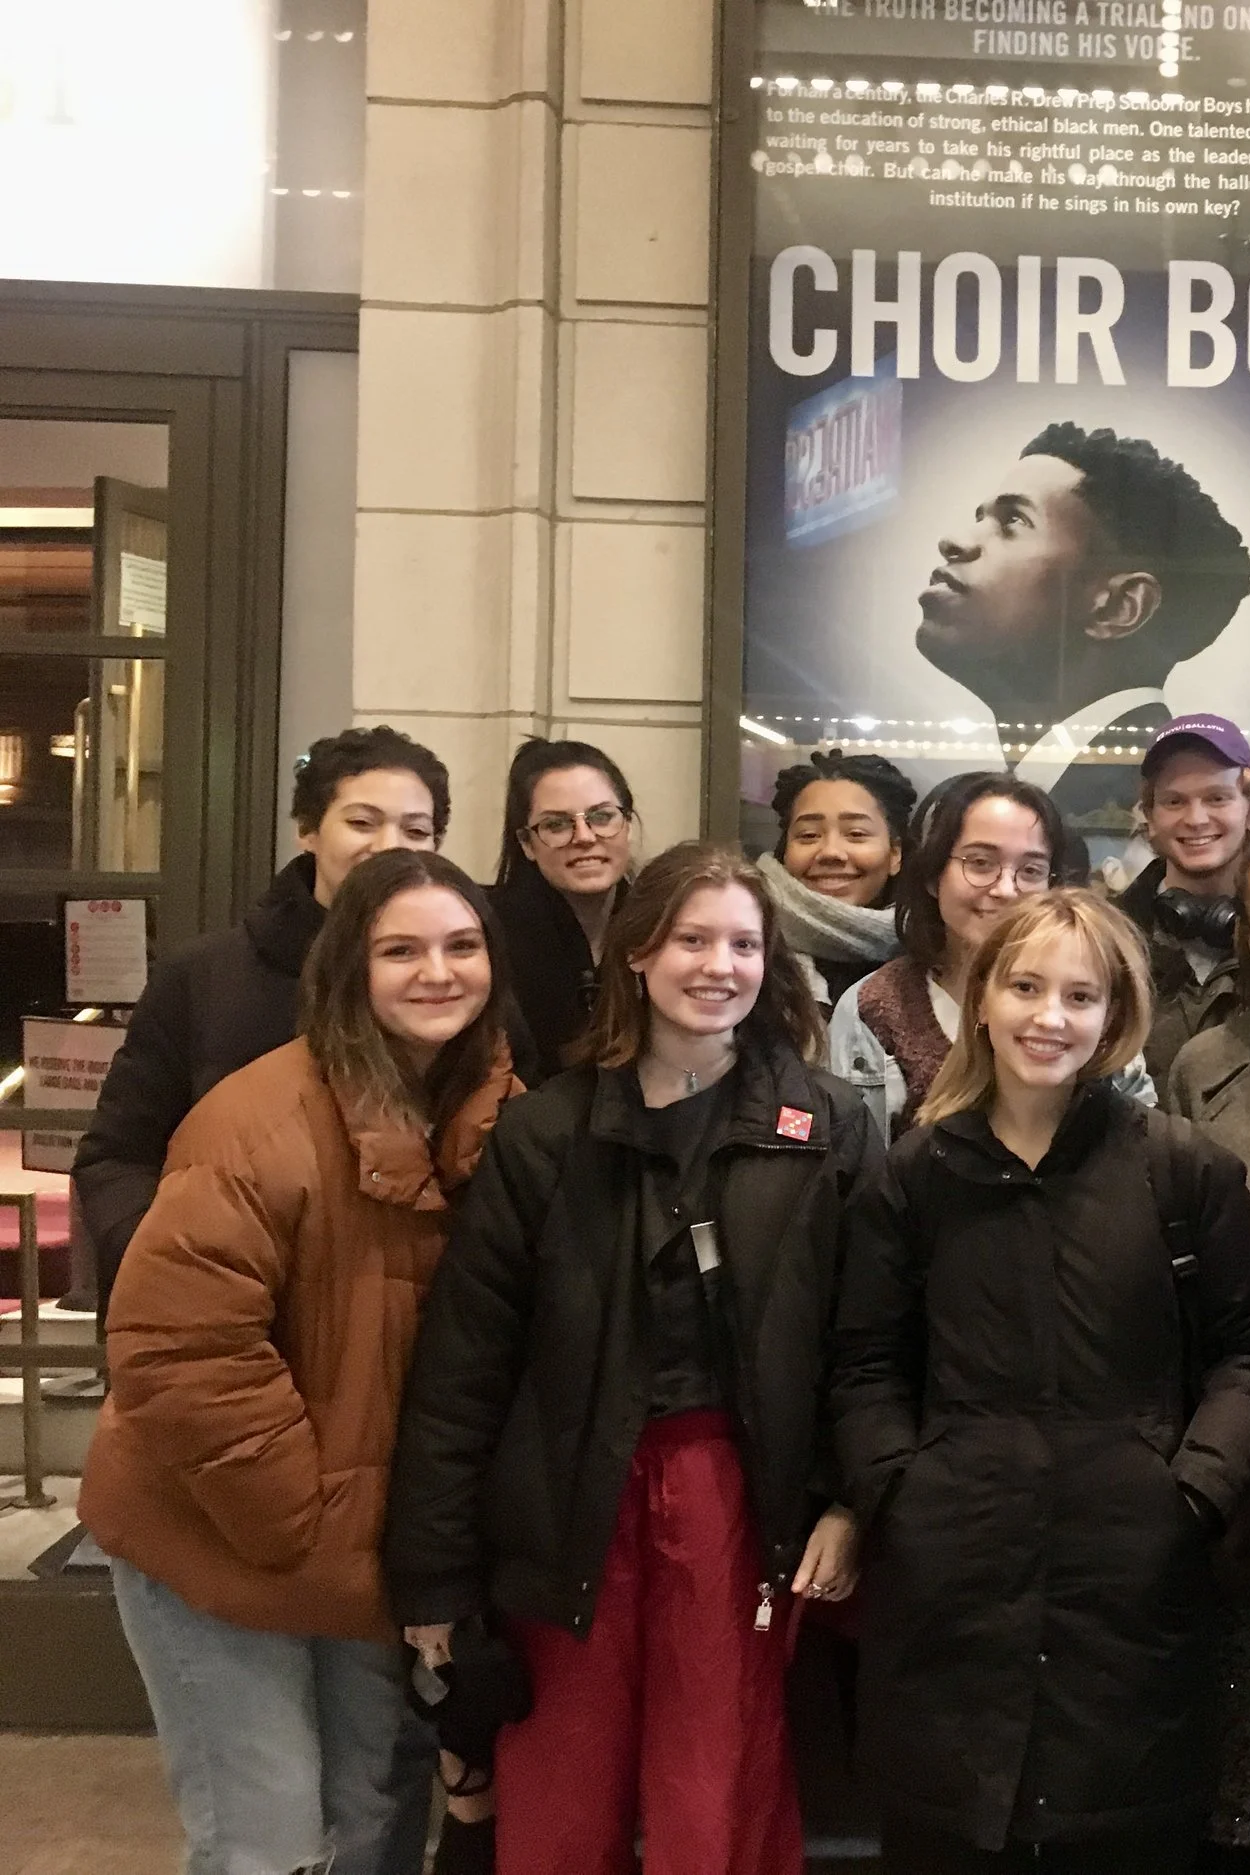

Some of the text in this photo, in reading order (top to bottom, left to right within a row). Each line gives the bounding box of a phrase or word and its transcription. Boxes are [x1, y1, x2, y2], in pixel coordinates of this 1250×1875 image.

[944, 0, 1067, 25] BECOMING
[1075, 1, 1089, 26] A
[1100, 2, 1161, 29] TRIAL
[1171, 3, 1215, 31] ND
[973, 29, 1201, 61] FINDING HIS VOIE.
[833, 88, 842, 99] a
[845, 86, 911, 105] century,
[946, 87, 1007, 105] Charles
[1012, 91, 1029, 107] R.
[1078, 93, 1116, 112] Prep
[1204, 97, 1242, 116] Boys
[766, 107, 783, 122] to
[788, 108, 815, 124] the
[820, 110, 903, 128] education
[908, 113, 925, 128] of
[929, 115, 986, 134] strong,
[991, 117, 1048, 133] ethical
[1053, 118, 1099, 135] black
[1103, 123, 1144, 137] men.
[1150, 121, 1182, 138] One
[766, 134, 827, 152] waiting
[836, 135, 859, 150] for
[865, 140, 910, 155] years
[918, 139, 935, 154] to
[943, 140, 978, 155] take
[987, 141, 1011, 157] his
[1020, 143, 1080, 161] rightful
[1089, 145, 1134, 163] place
[1142, 150, 1160, 162] as
[1169, 147, 1195, 163] the
[765, 160, 820, 178] gospe
[830, 160, 875, 177] choir.
[884, 162, 914, 179] But
[921, 166, 955, 180] can
[959, 165, 981, 182] he
[988, 166, 1033, 184] make
[1041, 166, 1065, 184] his
[1114, 170, 1176, 191] through
[1184, 173, 1210, 189] the
[929, 190, 1241, 218] institution if he sings in his own key?
[769, 245, 1127, 386] CHOIR
[1185, 723, 1225, 733] GALLATIN
